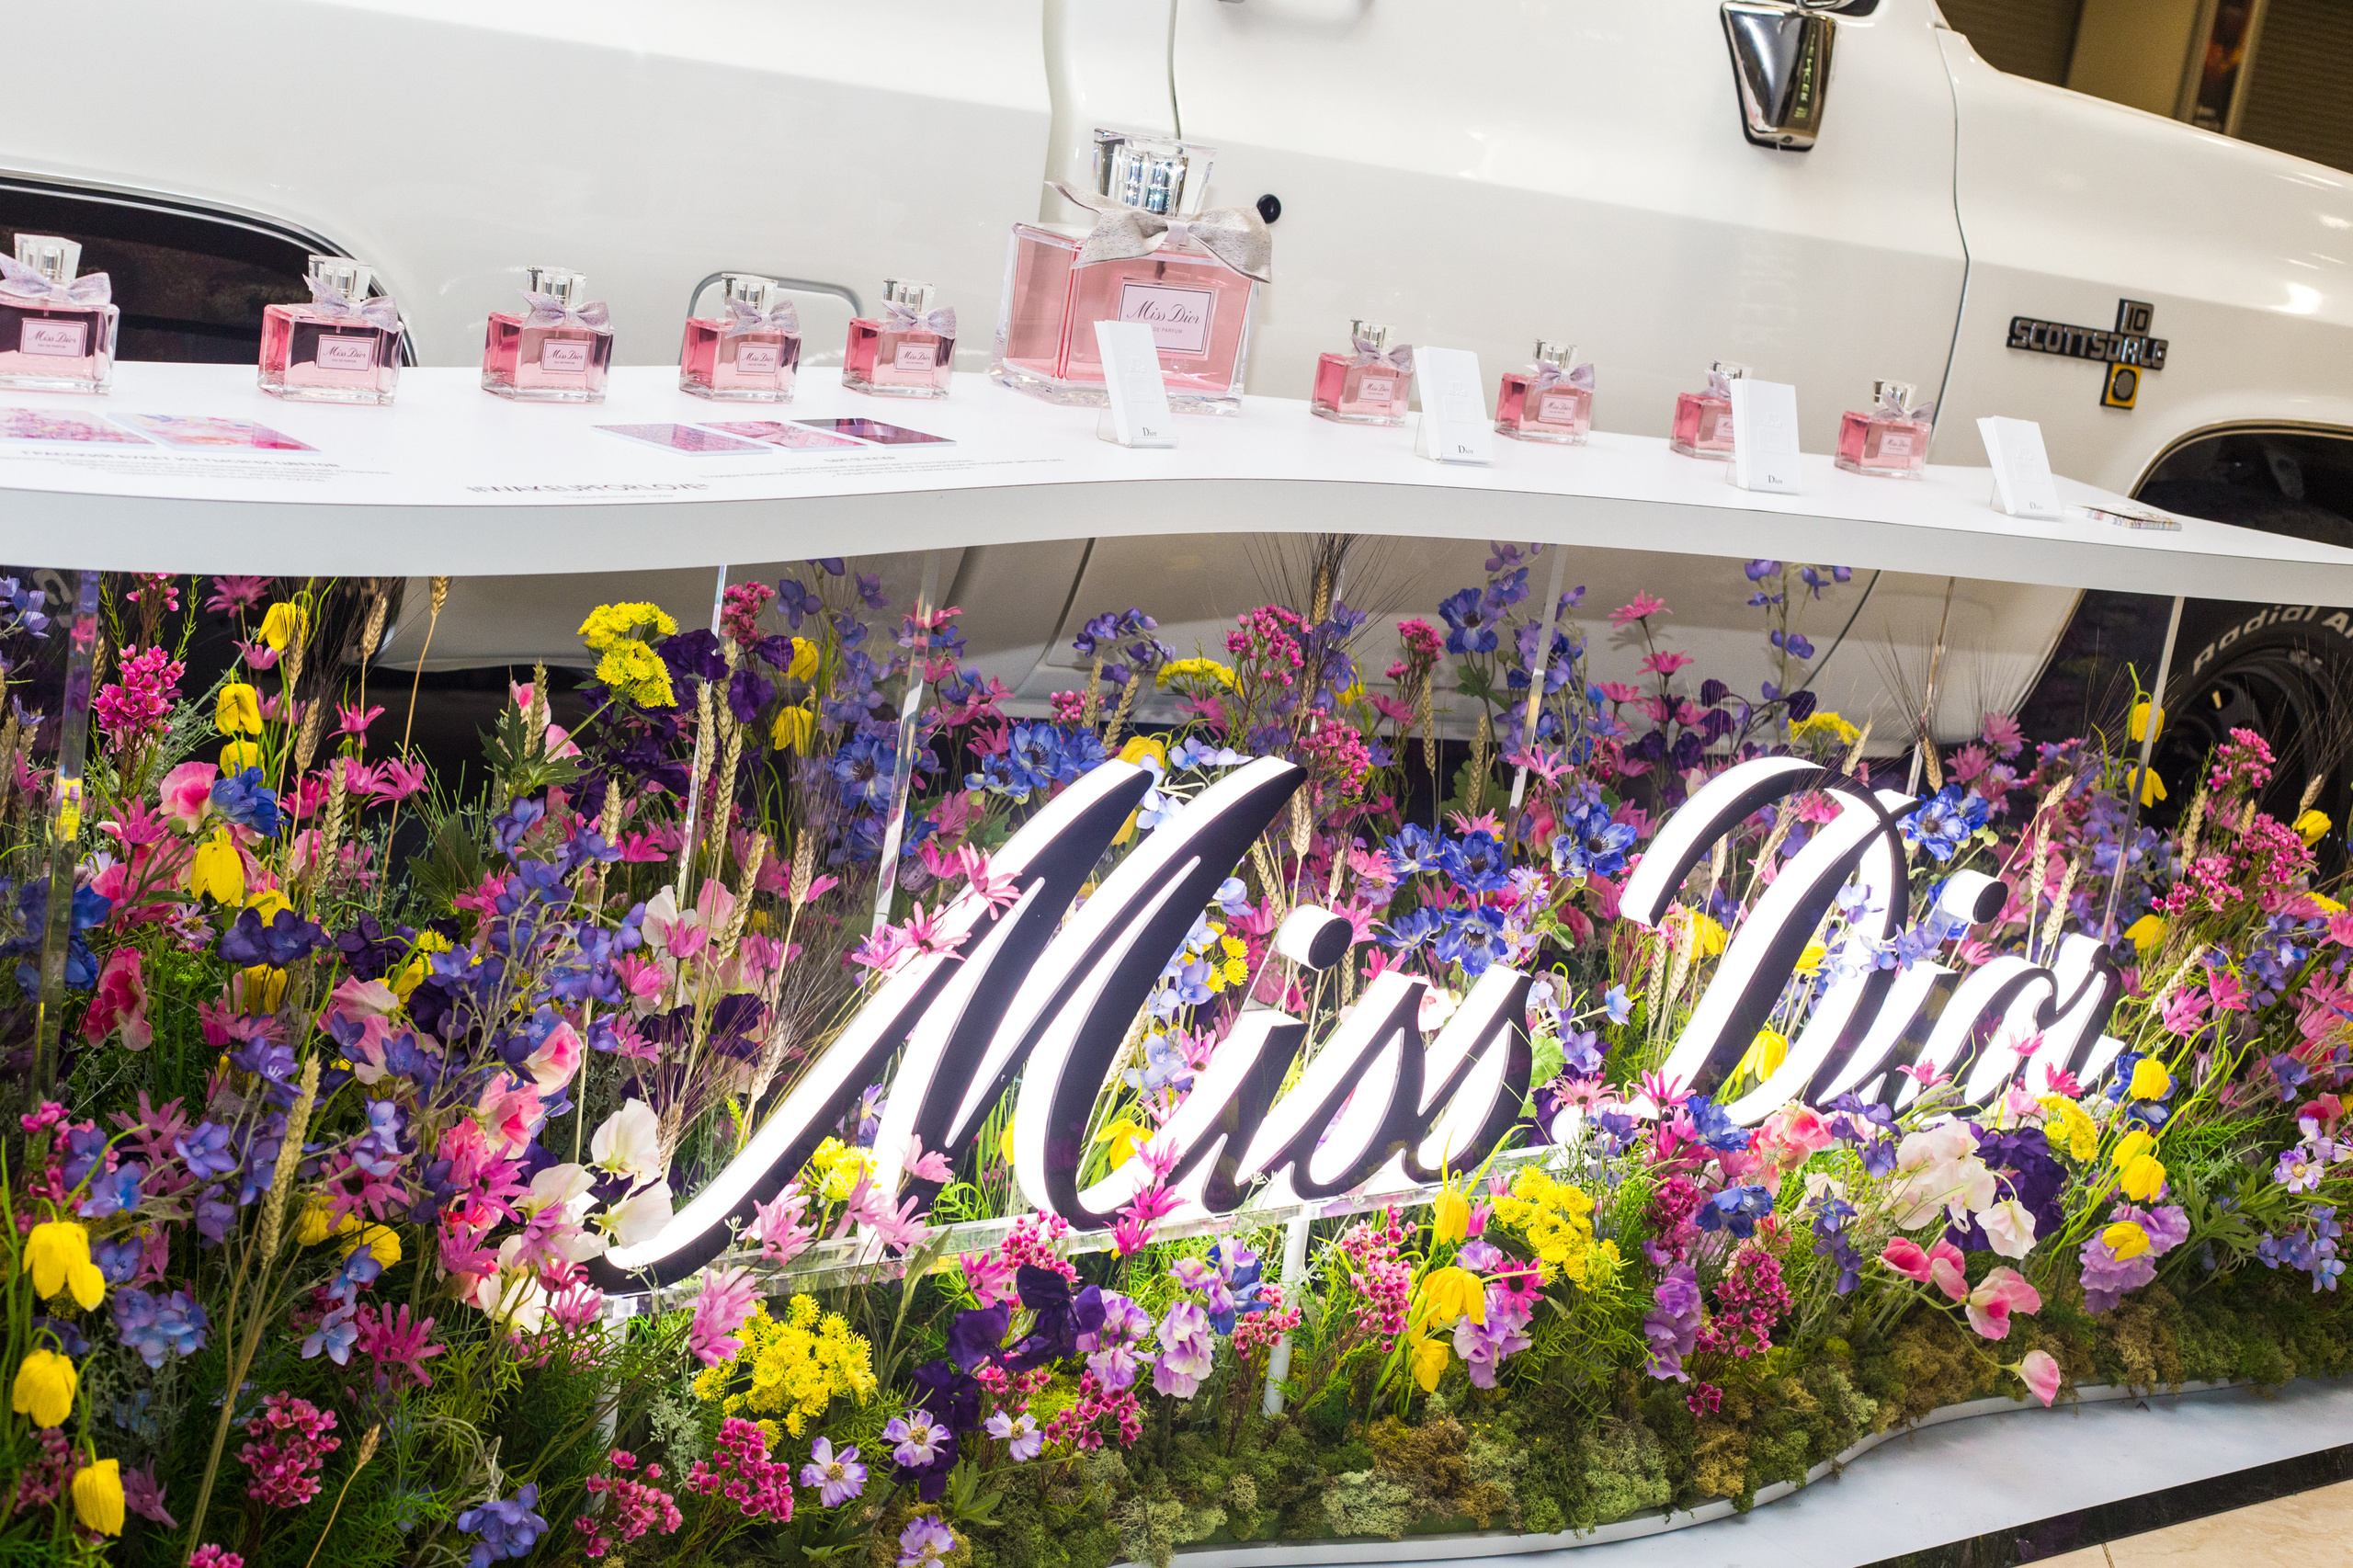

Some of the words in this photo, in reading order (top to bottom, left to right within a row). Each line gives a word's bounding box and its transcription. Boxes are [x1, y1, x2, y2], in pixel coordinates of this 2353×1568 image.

[1126, 301, 1165, 322] Miss
[1167, 303, 1199, 324] Dior
[2126, 307, 2150, 333] 10
[27, 330, 55, 342] Miss
[55, 332, 77, 344] Dior
[2009, 318, 2168, 369] SCOTTSDALE
[323, 346, 347, 357] Miss
[347, 347, 367, 358] Dior
[546, 348, 567, 359] Miss
[567, 349, 584, 359] Dior
[741, 351, 759, 361] Miss
[759, 352, 774, 362] Dior
[900, 350, 917, 360] Miss
[917, 351, 931, 361] Dior
[1142, 426, 1157, 437] Dior
[1458, 445, 1473, 454] Dior
[1768, 474, 1783, 483] Dior
[583, 755, 1533, 1296] Miss
[1552, 756, 2129, 1151] Dior
